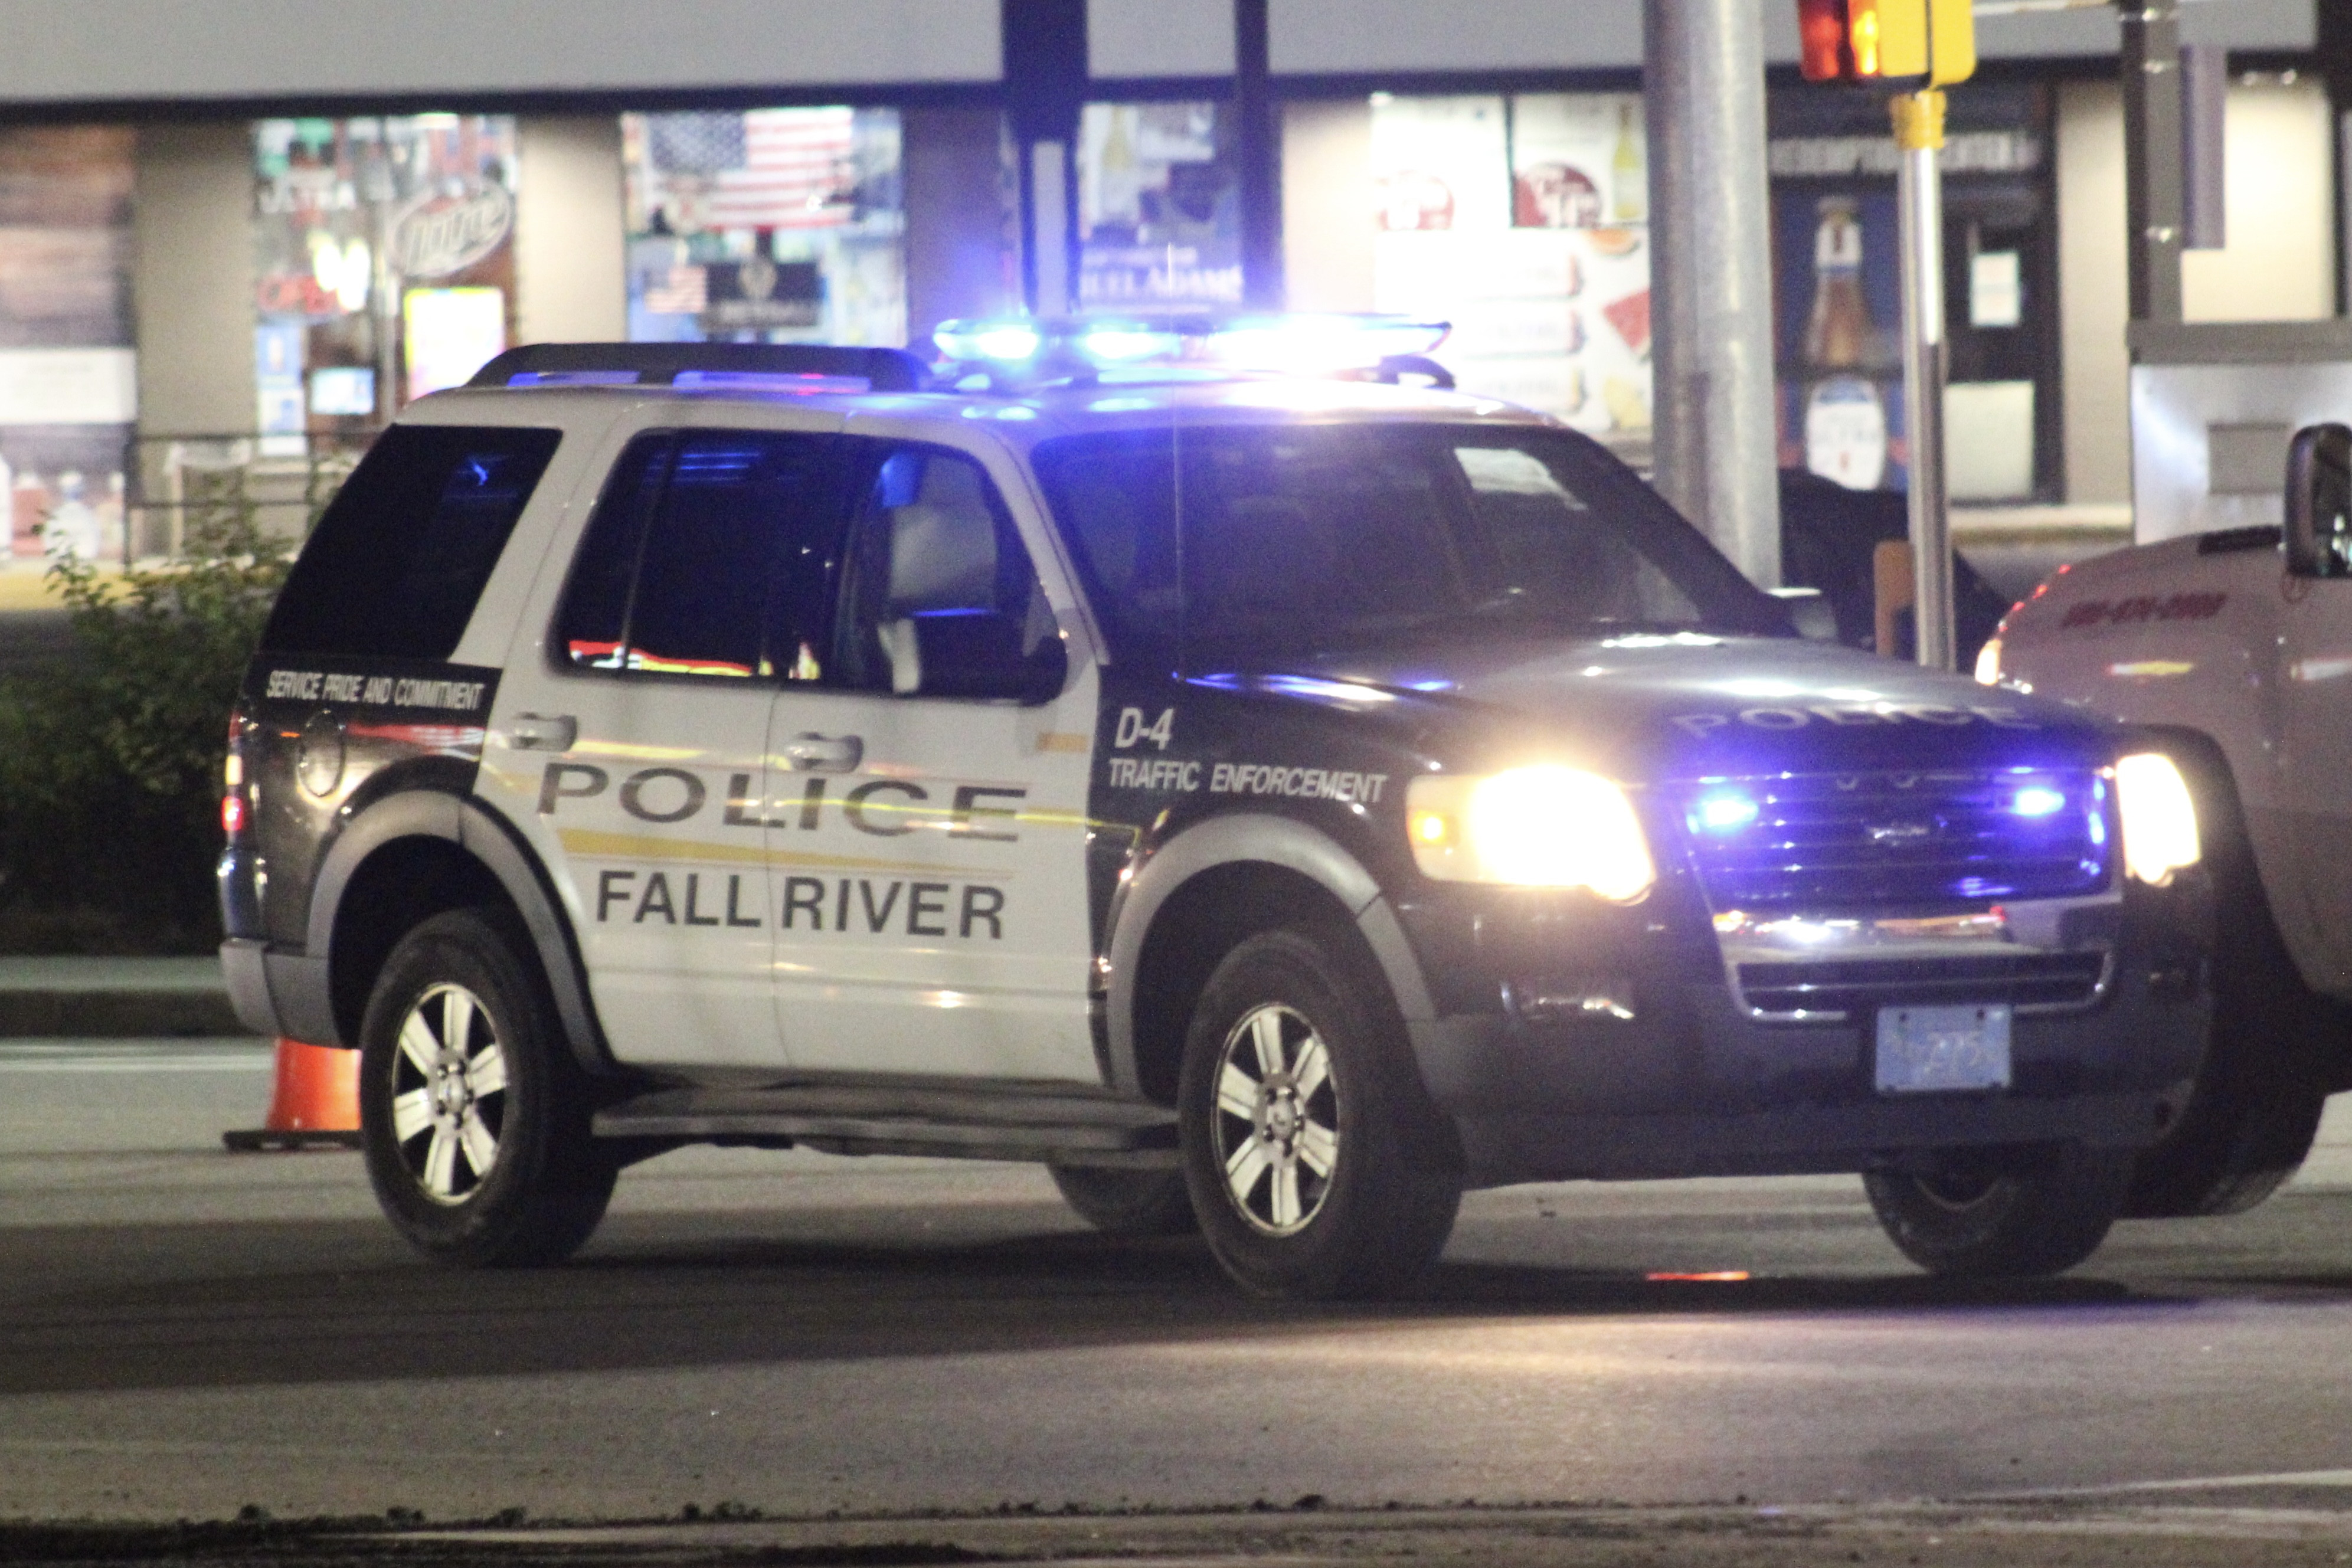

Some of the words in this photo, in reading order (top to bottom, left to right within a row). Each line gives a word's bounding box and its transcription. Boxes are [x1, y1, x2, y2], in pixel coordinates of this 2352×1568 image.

[267, 670, 323, 699] SERVICE
[322, 674, 364, 702] PRIDE
[363, 677, 392, 704] AND
[394, 678, 486, 710] COMMITMENT
[1115, 707, 1175, 751] D-4
[536, 762, 1028, 842] POLICE
[1109, 758, 1201, 792] TRAFFIC
[1210, 762, 1388, 804] ENFORCEMENT
[597, 870, 762, 928] FALL
[782, 876, 1006, 940] RIVER
